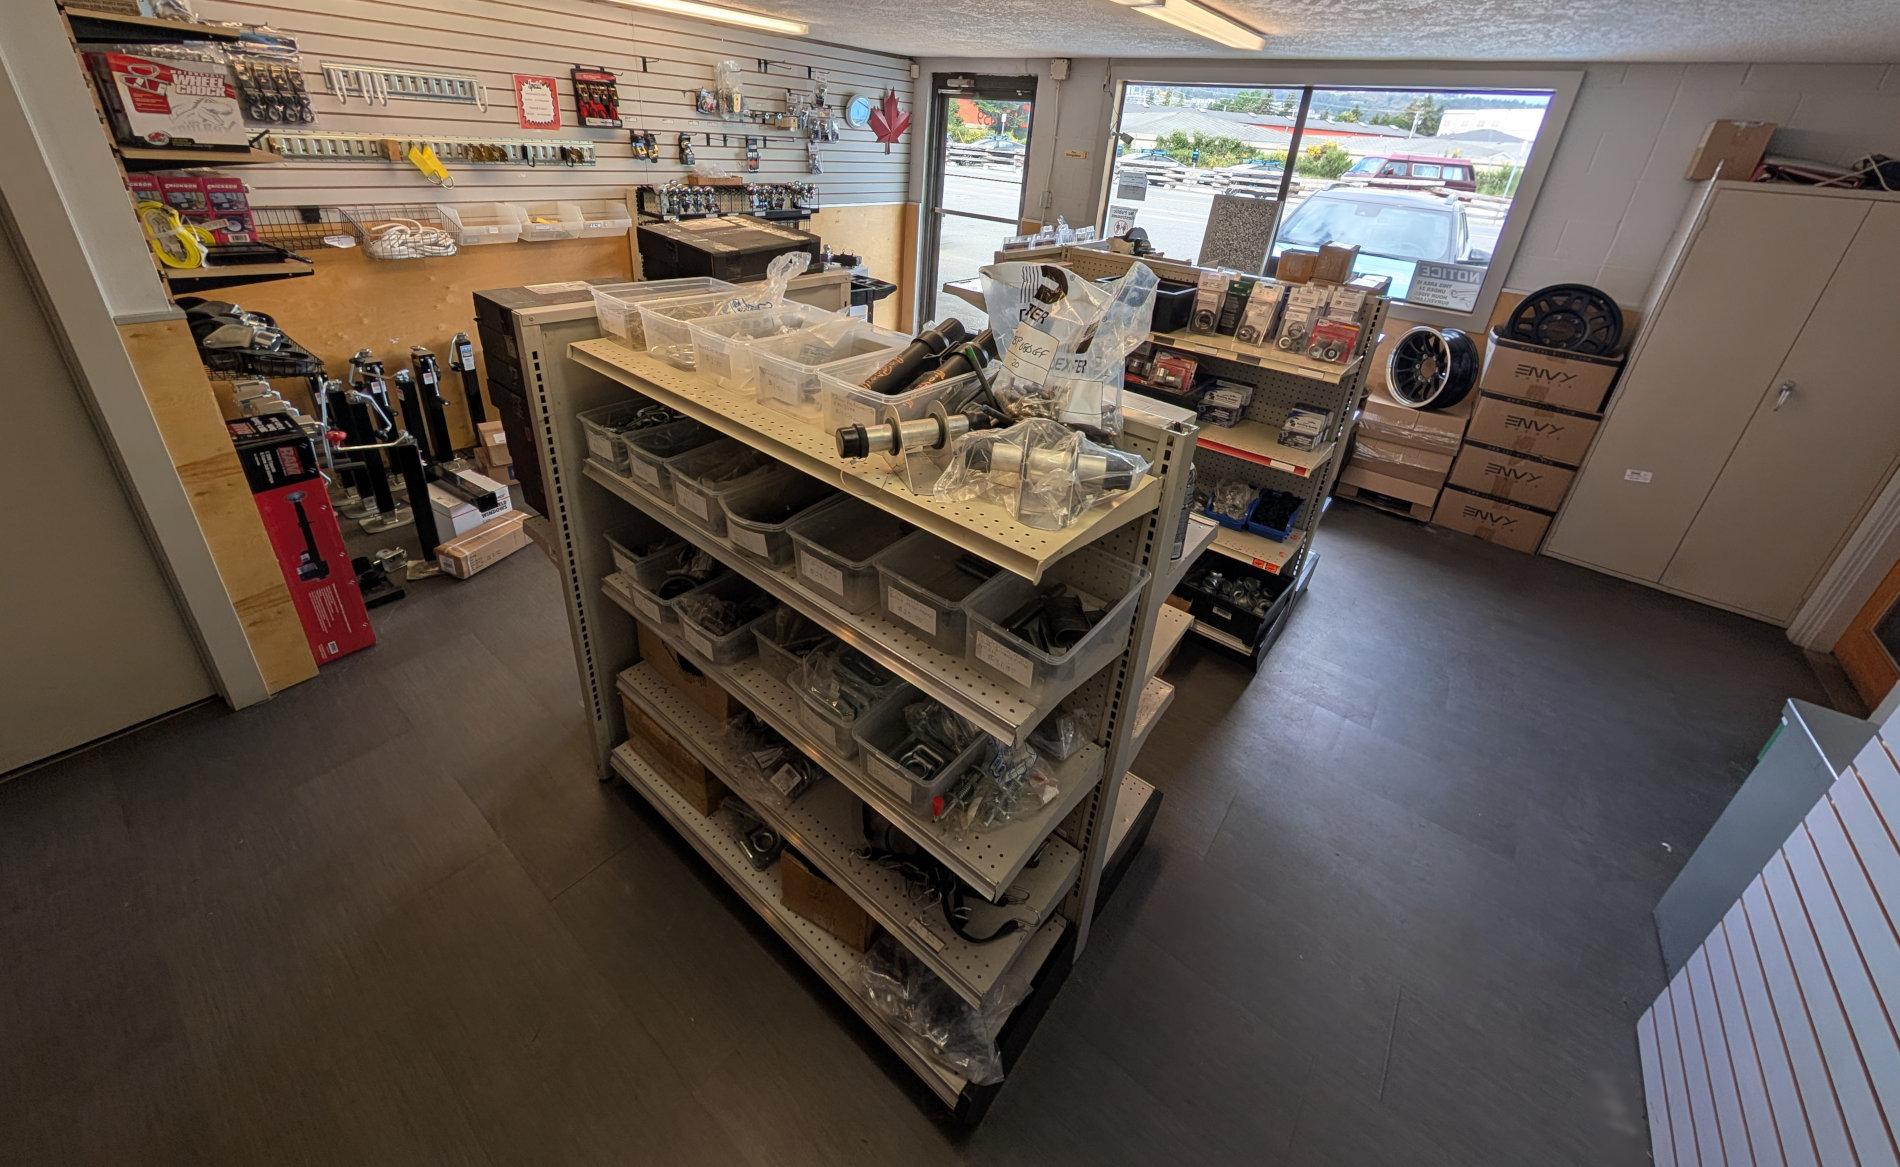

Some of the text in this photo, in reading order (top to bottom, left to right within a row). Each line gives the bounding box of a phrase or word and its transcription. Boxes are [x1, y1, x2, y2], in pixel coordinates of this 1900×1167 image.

[172, 73, 224, 88] WHEEL
[176, 84, 226, 96] CHOCK
[1514, 363, 1579, 383] ENVY
[1506, 415, 1565, 434] ENVY
[279, 446, 302, 476] RAM
[1485, 462, 1544, 482] ENVY
[1463, 505, 1519, 526] ENVY
